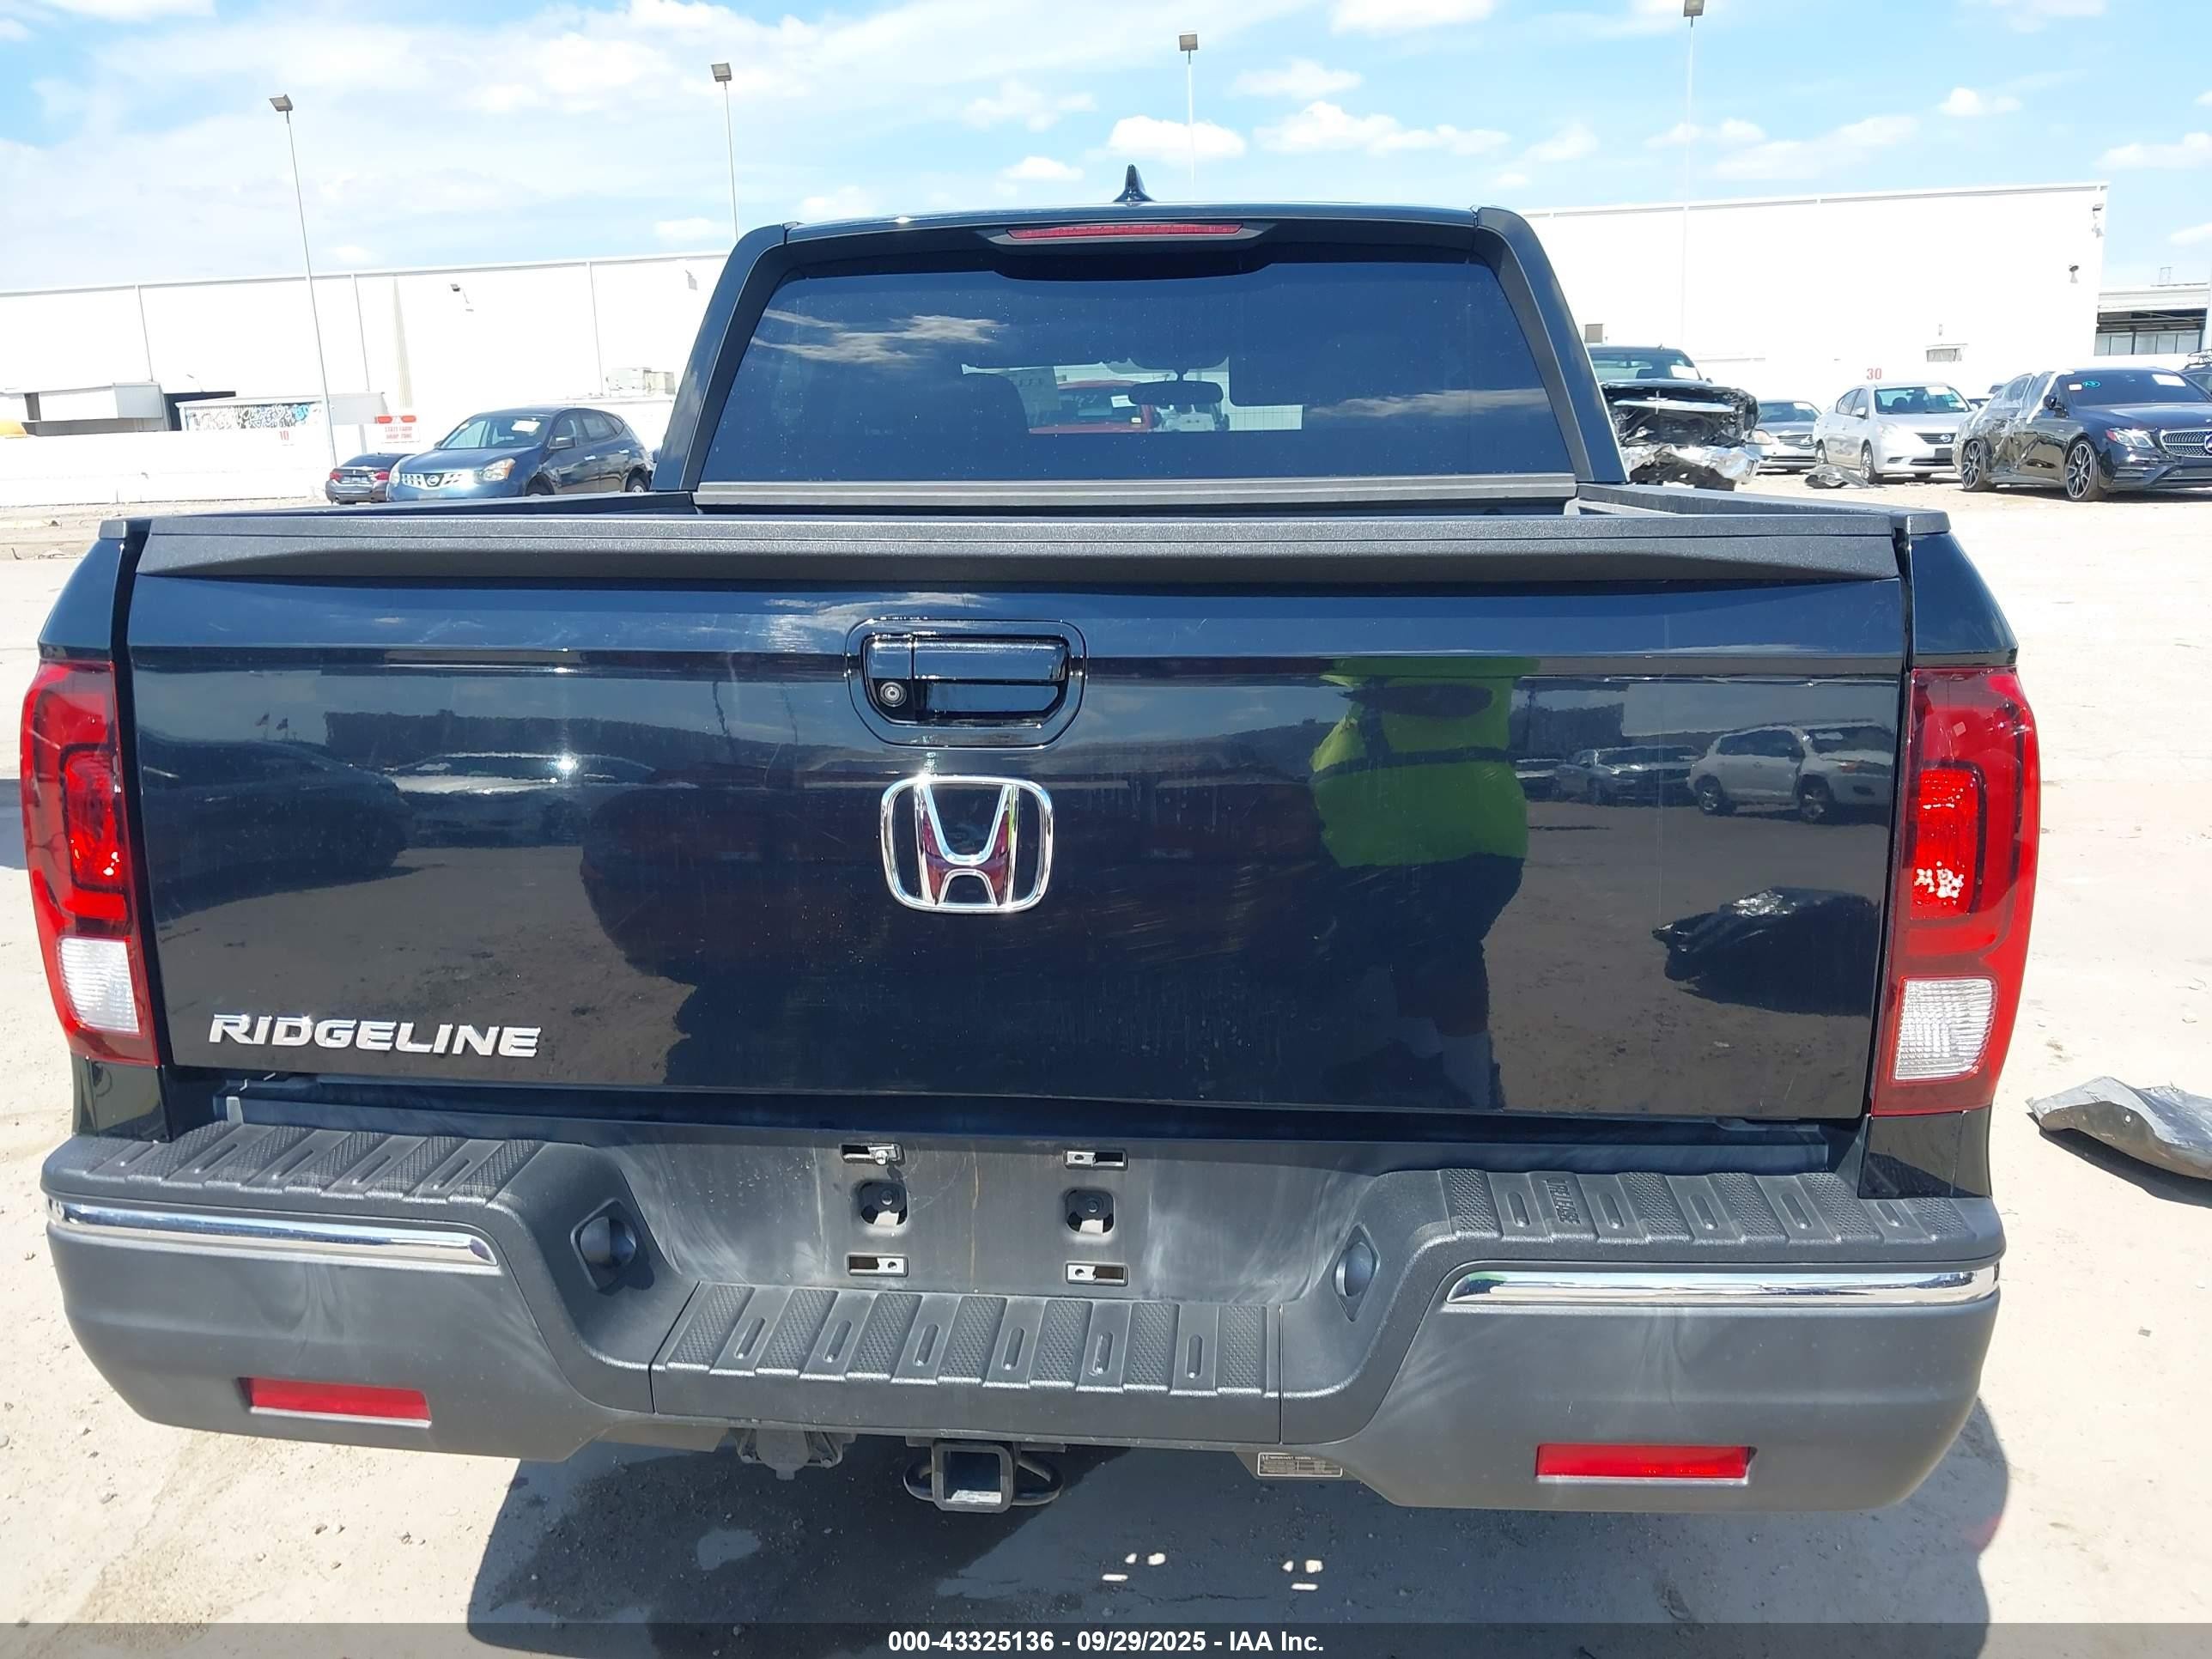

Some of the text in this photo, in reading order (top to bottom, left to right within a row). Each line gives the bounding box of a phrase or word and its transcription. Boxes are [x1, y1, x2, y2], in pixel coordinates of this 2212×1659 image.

[1867, 368, 1882, 380] 30
[279, 430, 289, 441] 10
[209, 1013, 542, 1058] RIDGELINE
